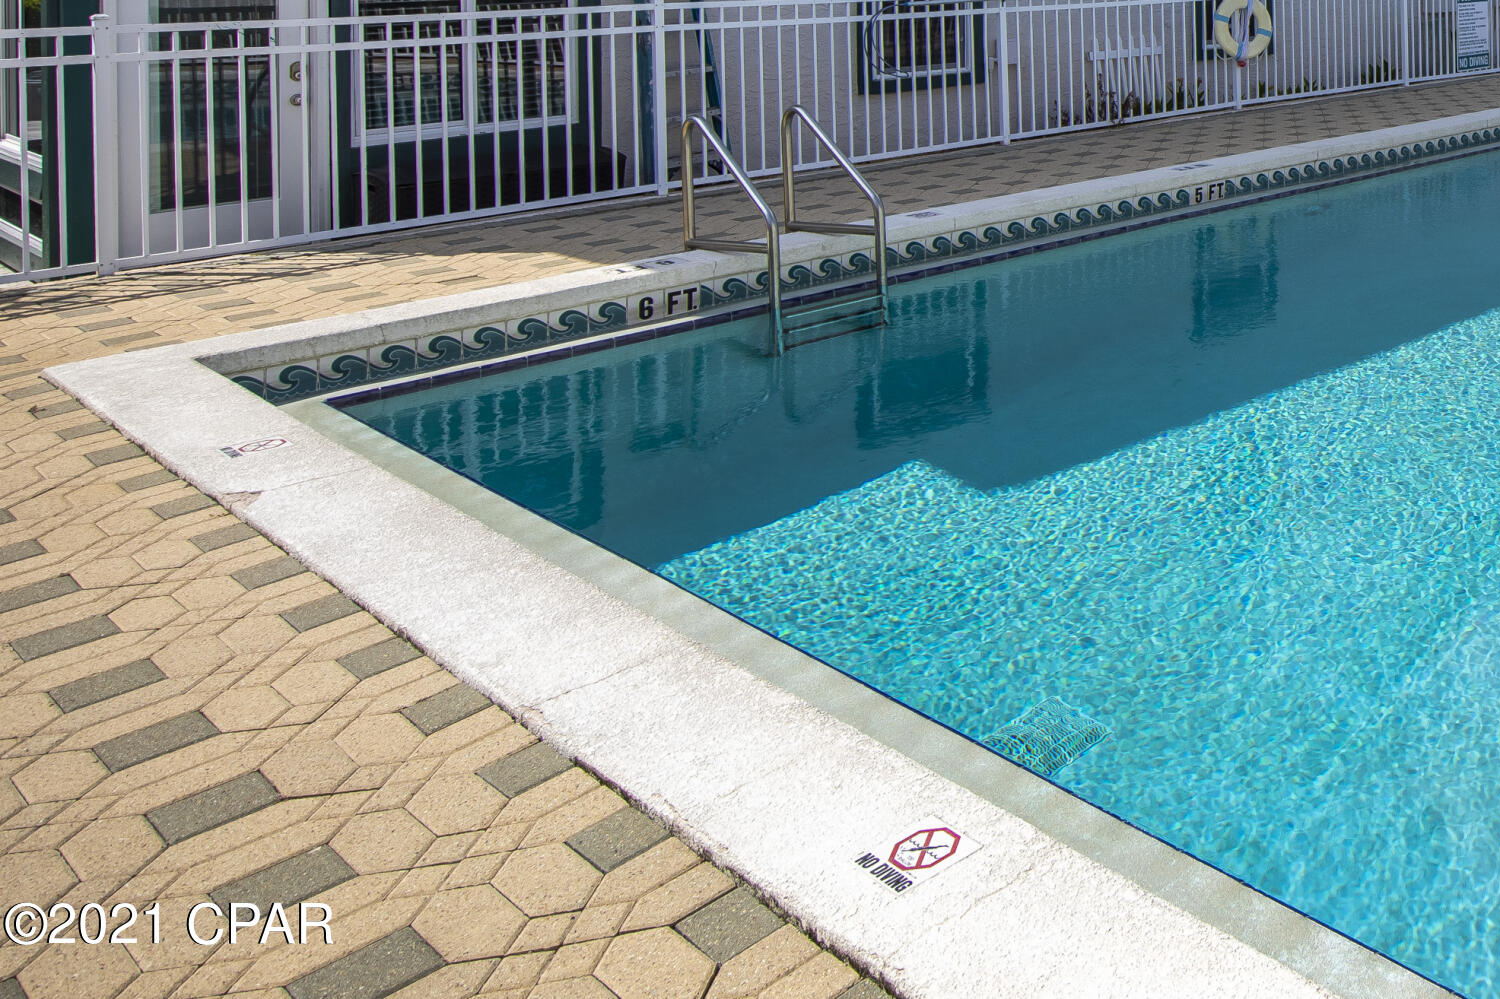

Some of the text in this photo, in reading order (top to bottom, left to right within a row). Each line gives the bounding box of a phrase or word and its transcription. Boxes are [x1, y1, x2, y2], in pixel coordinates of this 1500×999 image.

[1459, 55, 1489, 69] NO DIVING
[1195, 182, 1225, 203] 5 FT.
[638, 287, 699, 321] 6 FT.
[854, 852, 913, 893] NO DIVING
